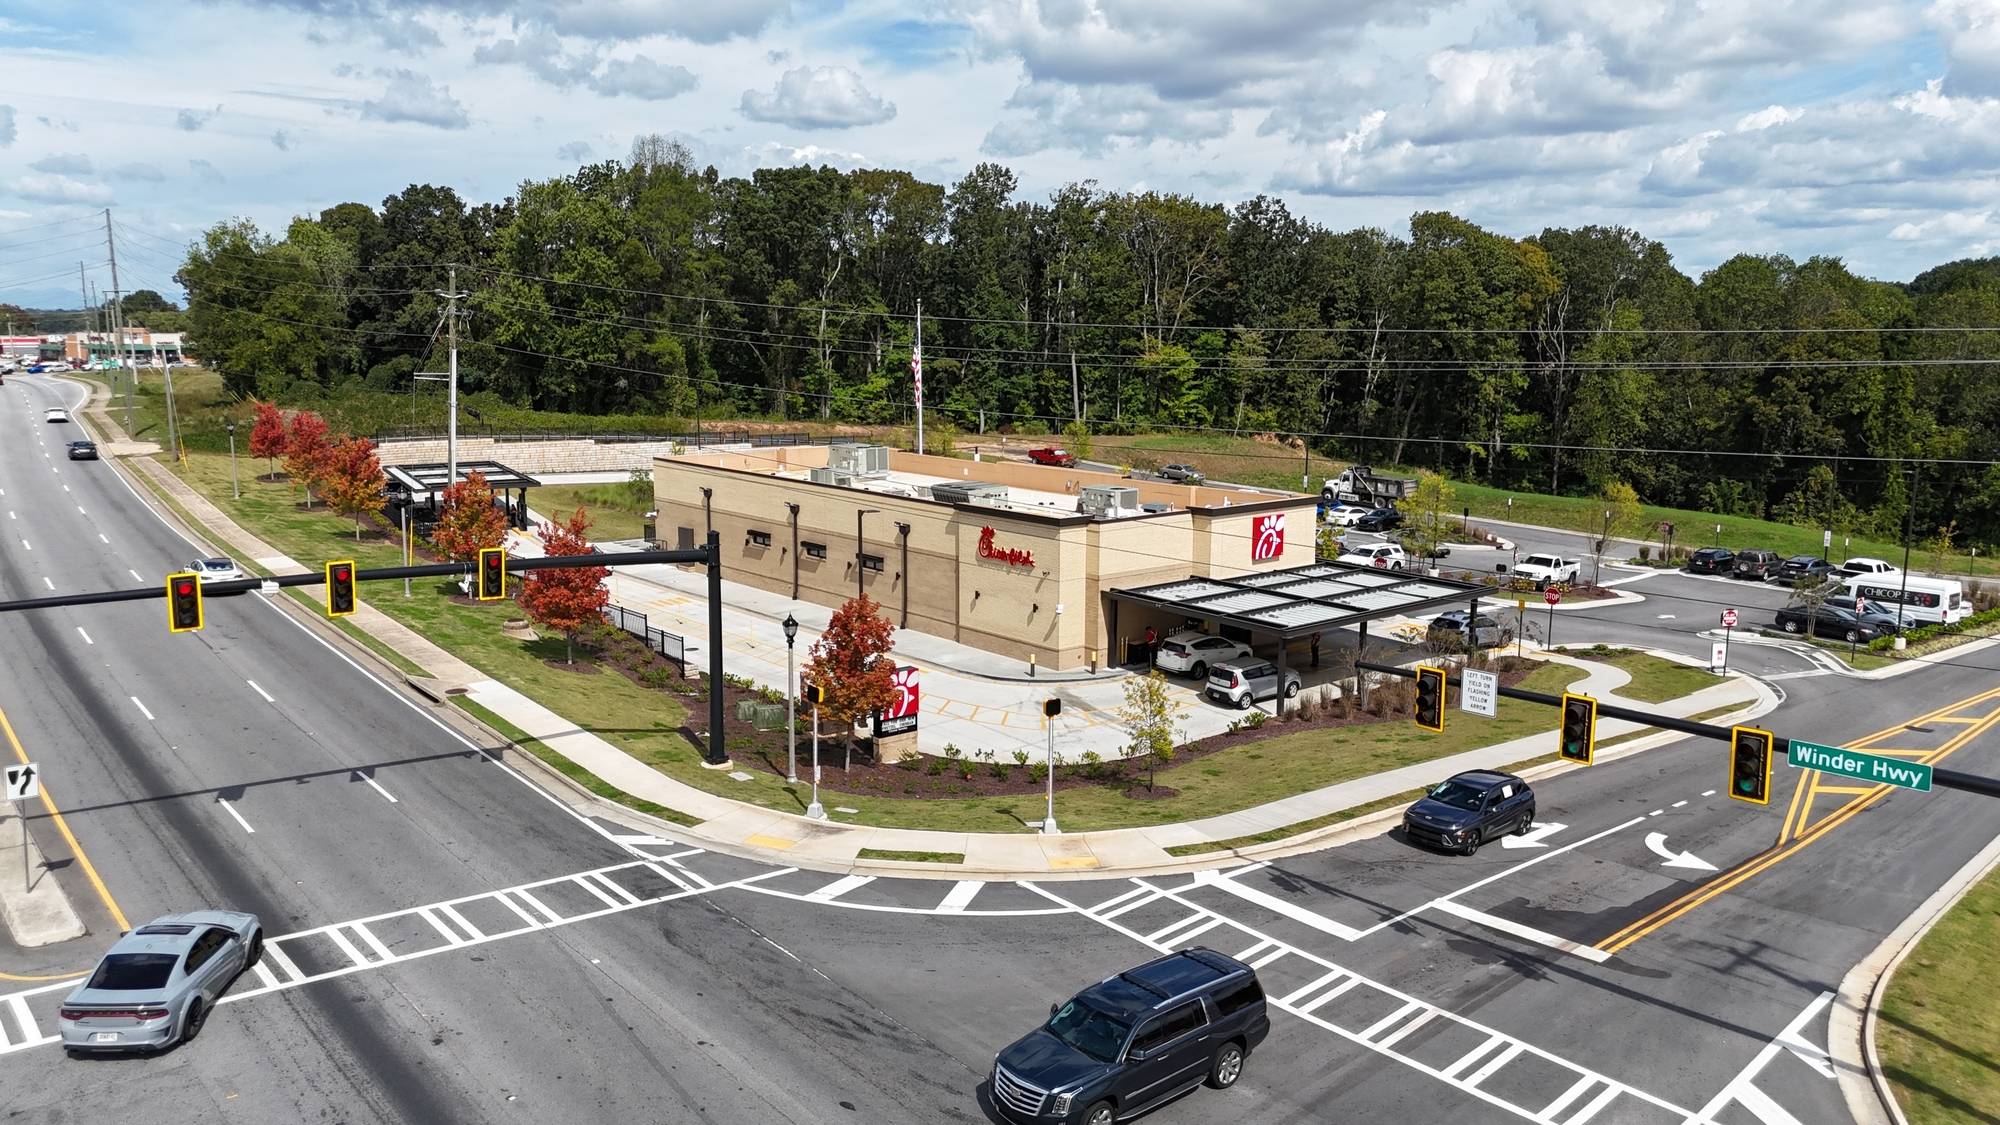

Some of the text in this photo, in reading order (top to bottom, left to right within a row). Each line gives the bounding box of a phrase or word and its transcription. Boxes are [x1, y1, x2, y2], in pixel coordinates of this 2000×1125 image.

[1545, 592, 1560, 601] STOP
[1864, 587, 1911, 600] CHICOPE
[1468, 680, 1482, 688] YIELD
[1467, 687, 1490, 697] FLASHING
[1469, 695, 1488, 704] YELLOW
[1470, 703, 1486, 711] ARROW
[1796, 745, 1923, 788] Winder Hwy
